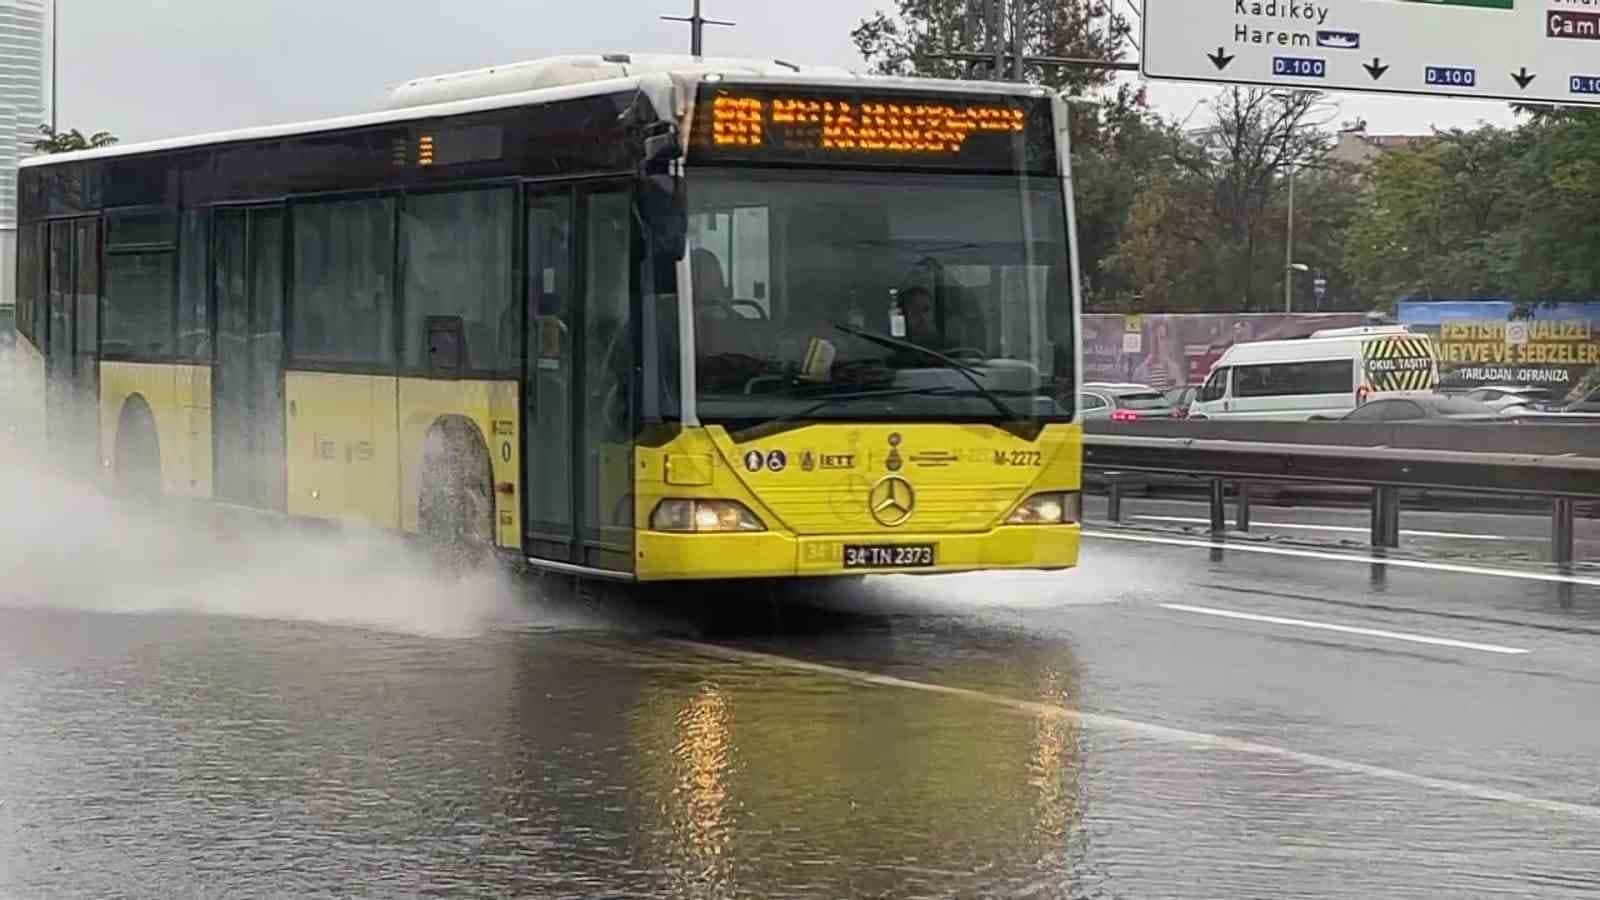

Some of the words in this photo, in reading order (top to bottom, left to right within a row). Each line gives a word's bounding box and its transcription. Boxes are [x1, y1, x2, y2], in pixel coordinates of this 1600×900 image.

[1234, 0, 1328, 25] Kadıköy
[1234, 23, 1311, 47] Harem
[1274, 60, 1323, 75] D.100
[1427, 68, 1473, 84] D.100
[1369, 359, 1396, 370] OKUL
[1461, 367, 1512, 380] TARLADAN
[994, 450, 1041, 467] M-2272
[847, 549, 866, 565] 34
[871, 548, 892, 565] TN
[896, 547, 931, 564] 2373
